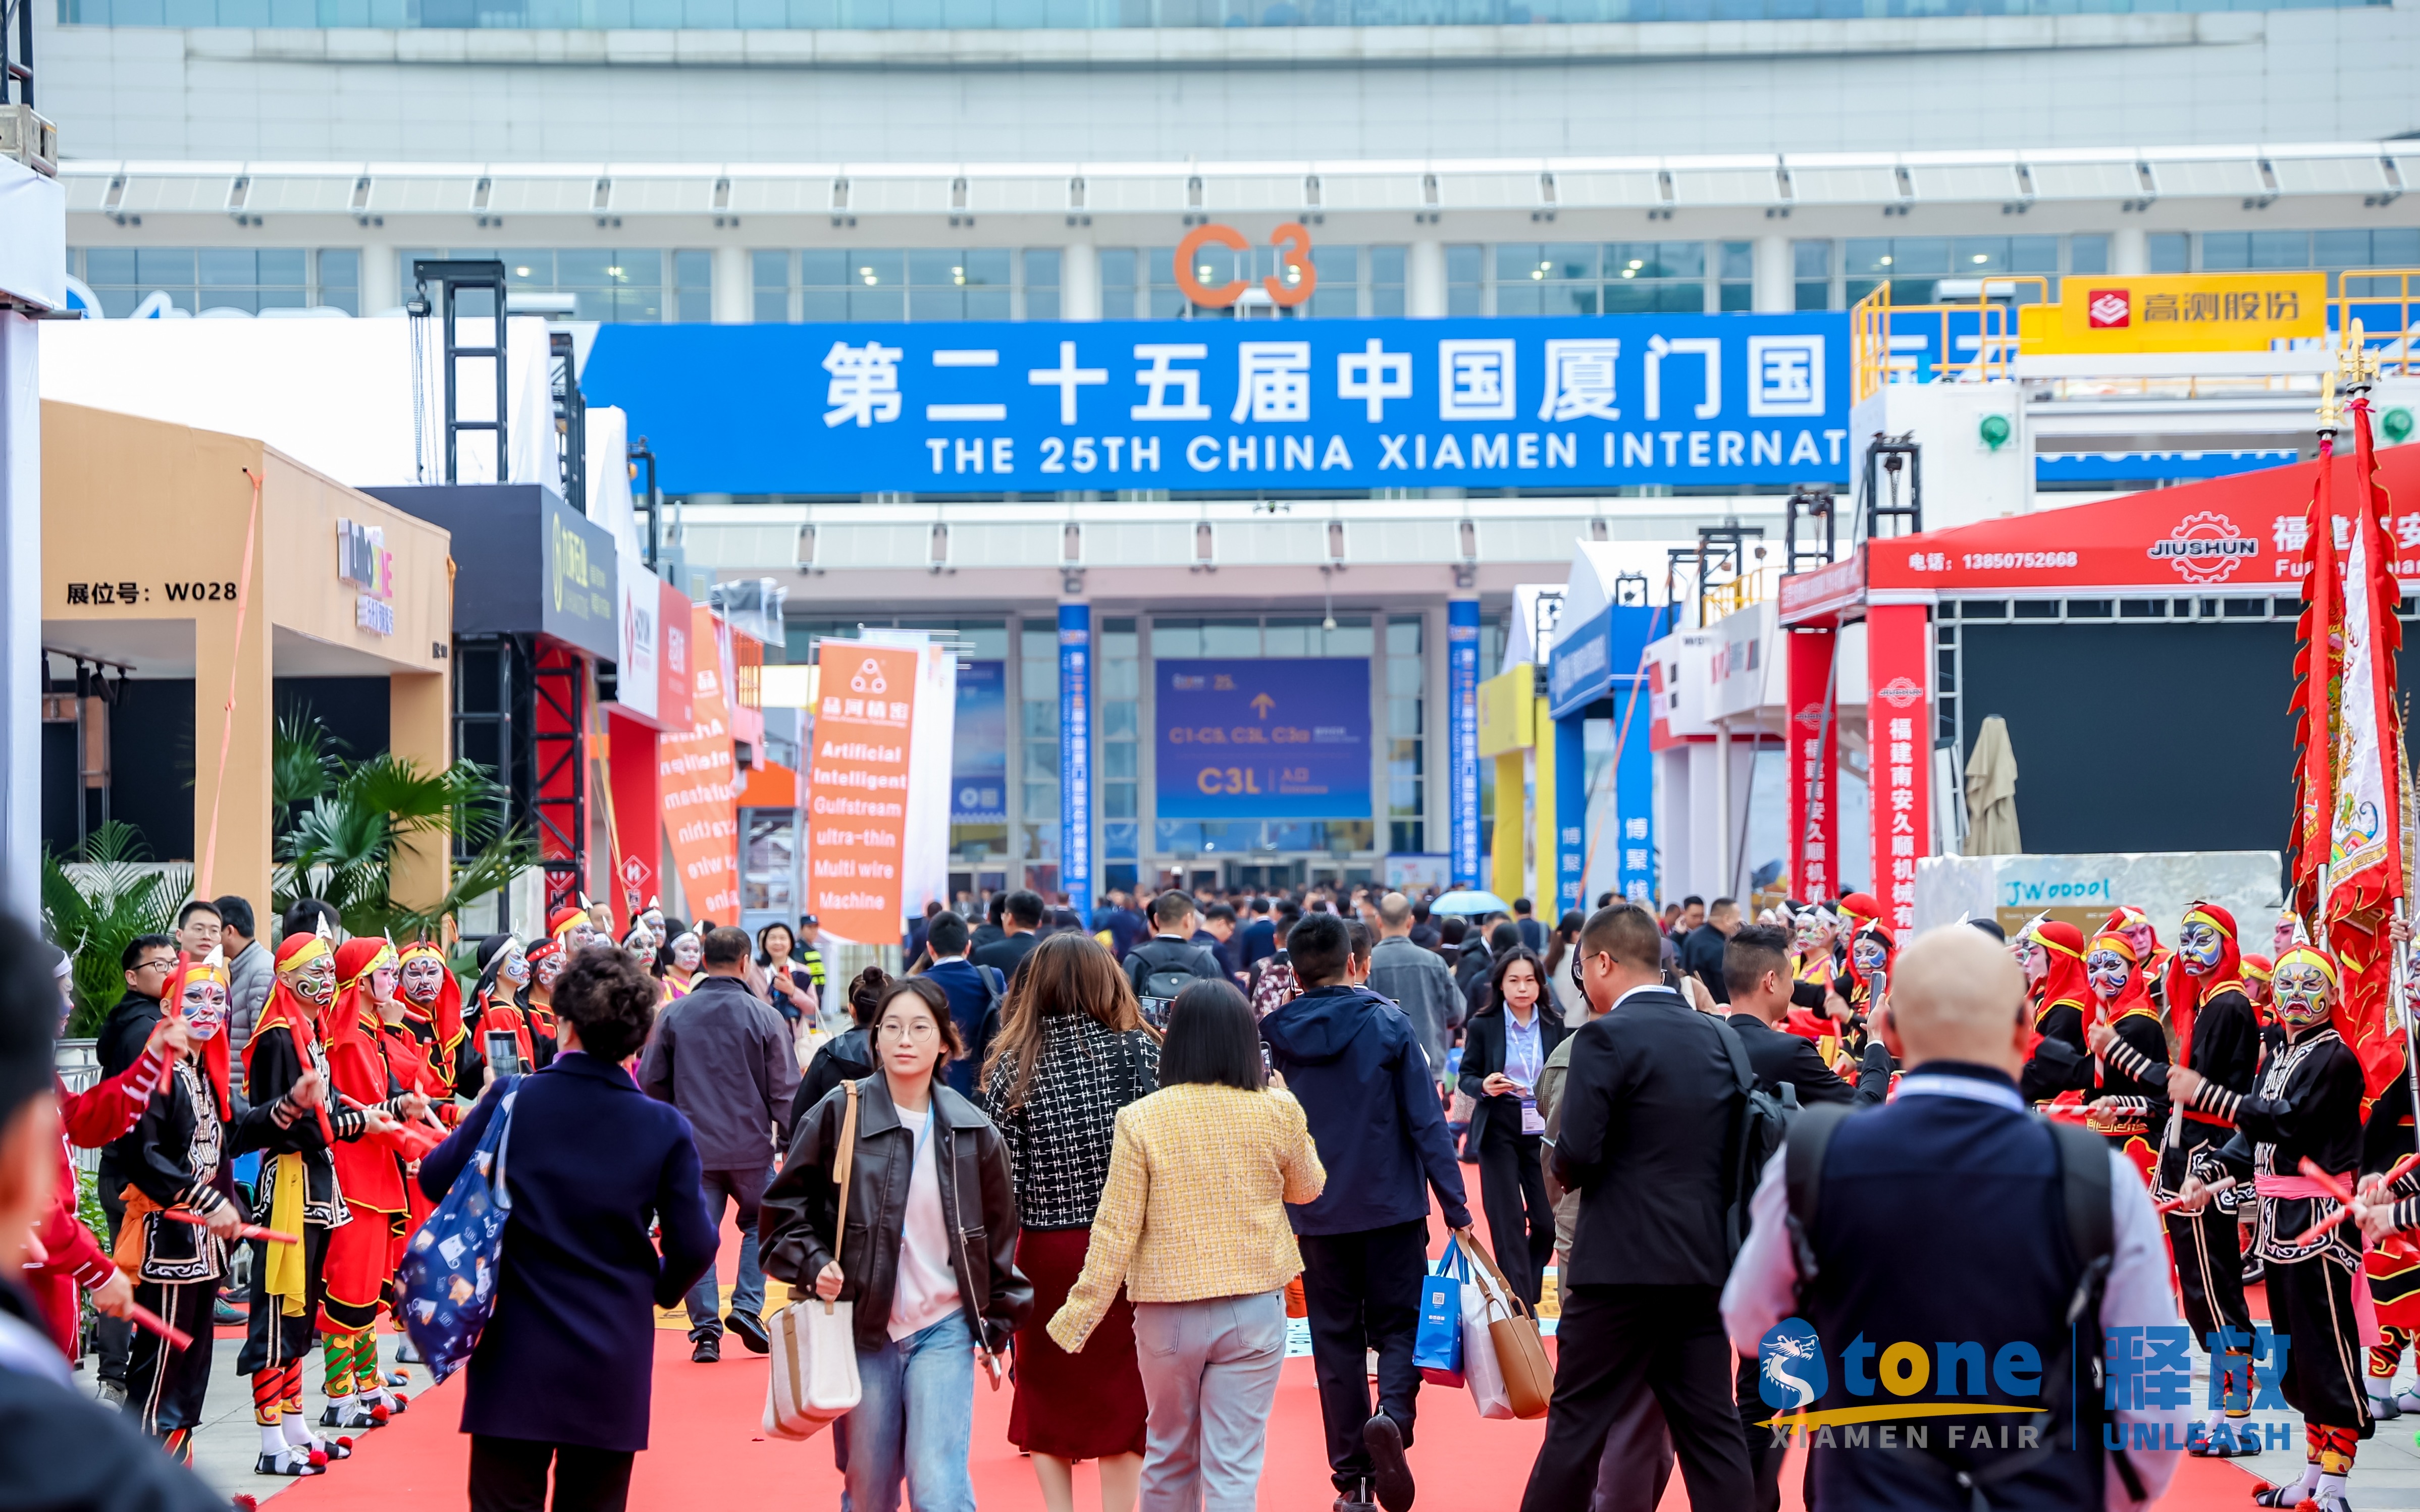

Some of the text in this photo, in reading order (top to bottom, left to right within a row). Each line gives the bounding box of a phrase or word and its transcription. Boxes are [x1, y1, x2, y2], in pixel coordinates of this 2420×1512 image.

[1173, 222, 1317, 307] C3
[2144, 291, 2299, 322] 高测股份
[926, 438, 1014, 474] THE
[1040, 436, 1161, 473] 25TH
[1186, 435, 1353, 472] CHINA
[1378, 432, 1576, 470] XIAMEN
[2150, 540, 2256, 557] JIUSHUN
[1962, 551, 2078, 570] 13850752668
[165, 582, 237, 601] W028
[821, 740, 902, 763] Artificial
[814, 767, 907, 790] Intelligent
[1197, 767, 1261, 794] C3L
[814, 795, 902, 818] Gulfstream
[816, 827, 896, 848] ultra-thin
[814, 859, 894, 880] Multi wire
[819, 891, 885, 910] Machine
